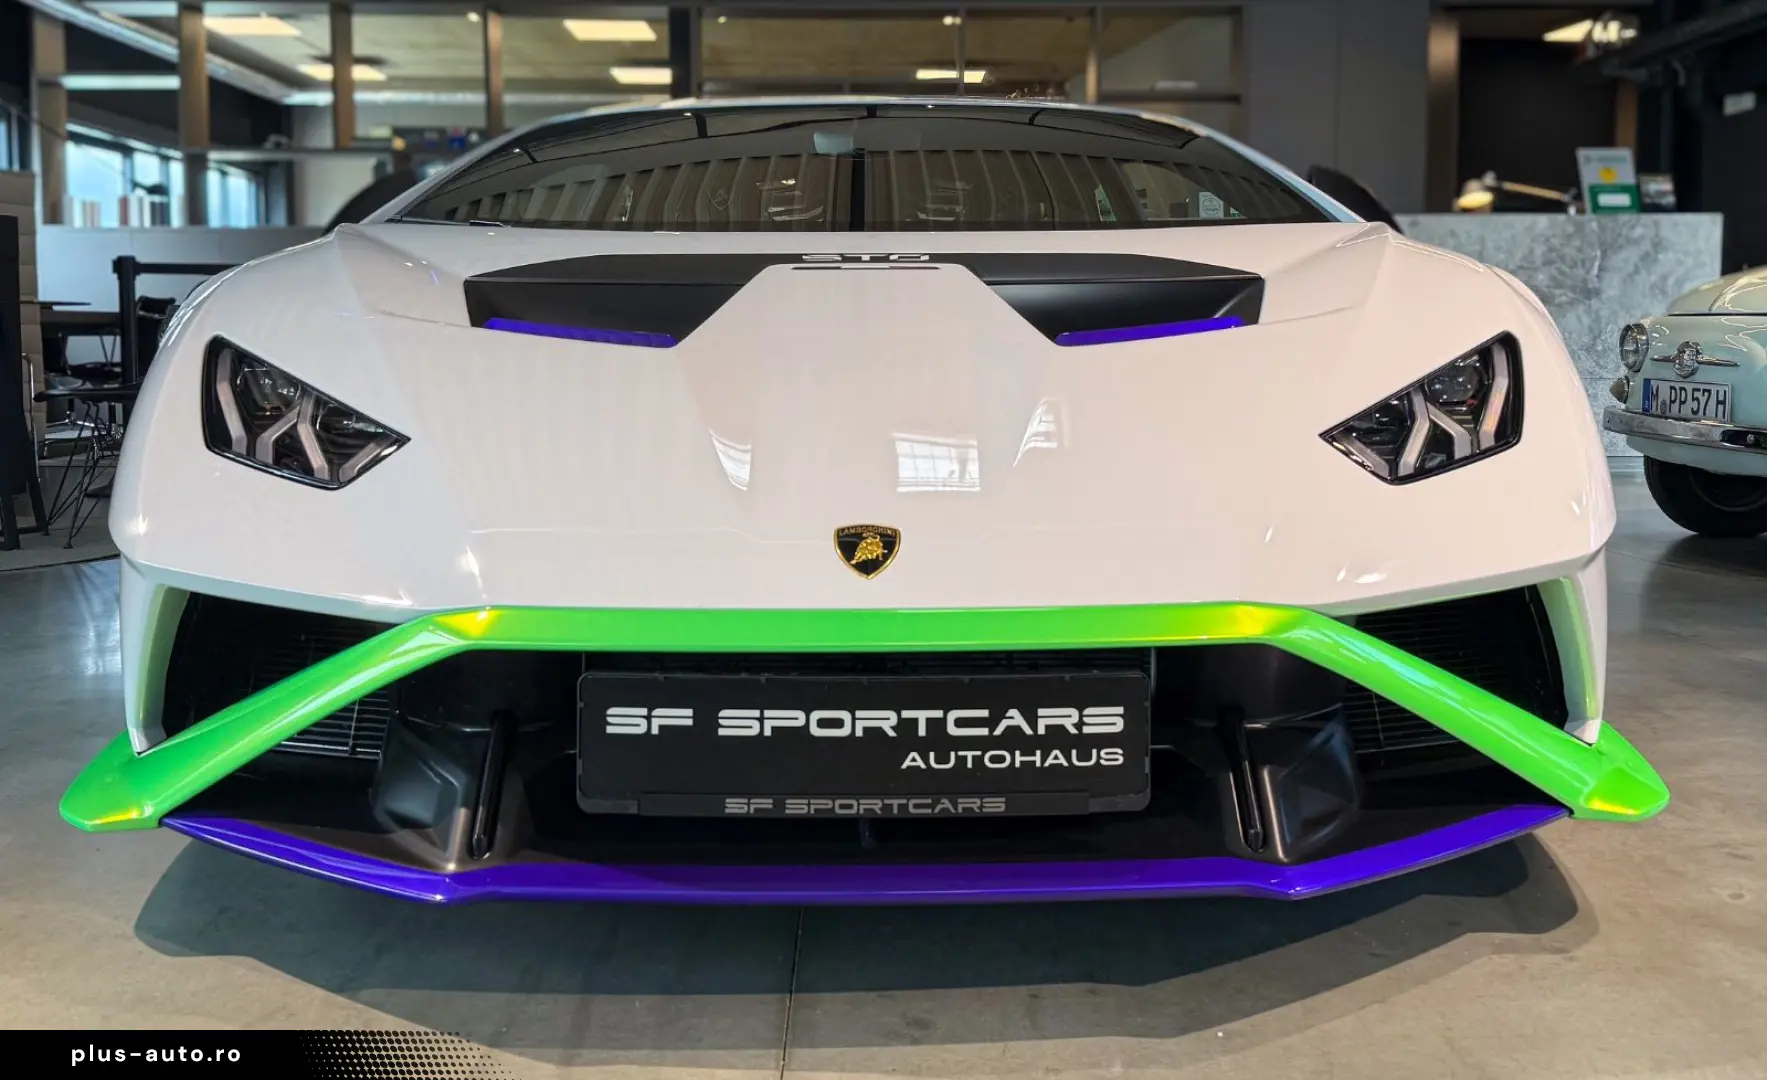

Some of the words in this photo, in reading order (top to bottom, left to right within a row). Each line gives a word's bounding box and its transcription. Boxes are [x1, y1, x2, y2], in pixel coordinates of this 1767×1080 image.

[1650, 384, 1660, 413] M
[1668, 385, 1688, 414] PP
[605, 707, 694, 735] SF
[717, 706, 1124, 737] SPORTCARS
[900, 747, 1124, 769] AUTOHAUS
[724, 798, 774, 814] SF
[784, 797, 1006, 814] SPORTCARS
